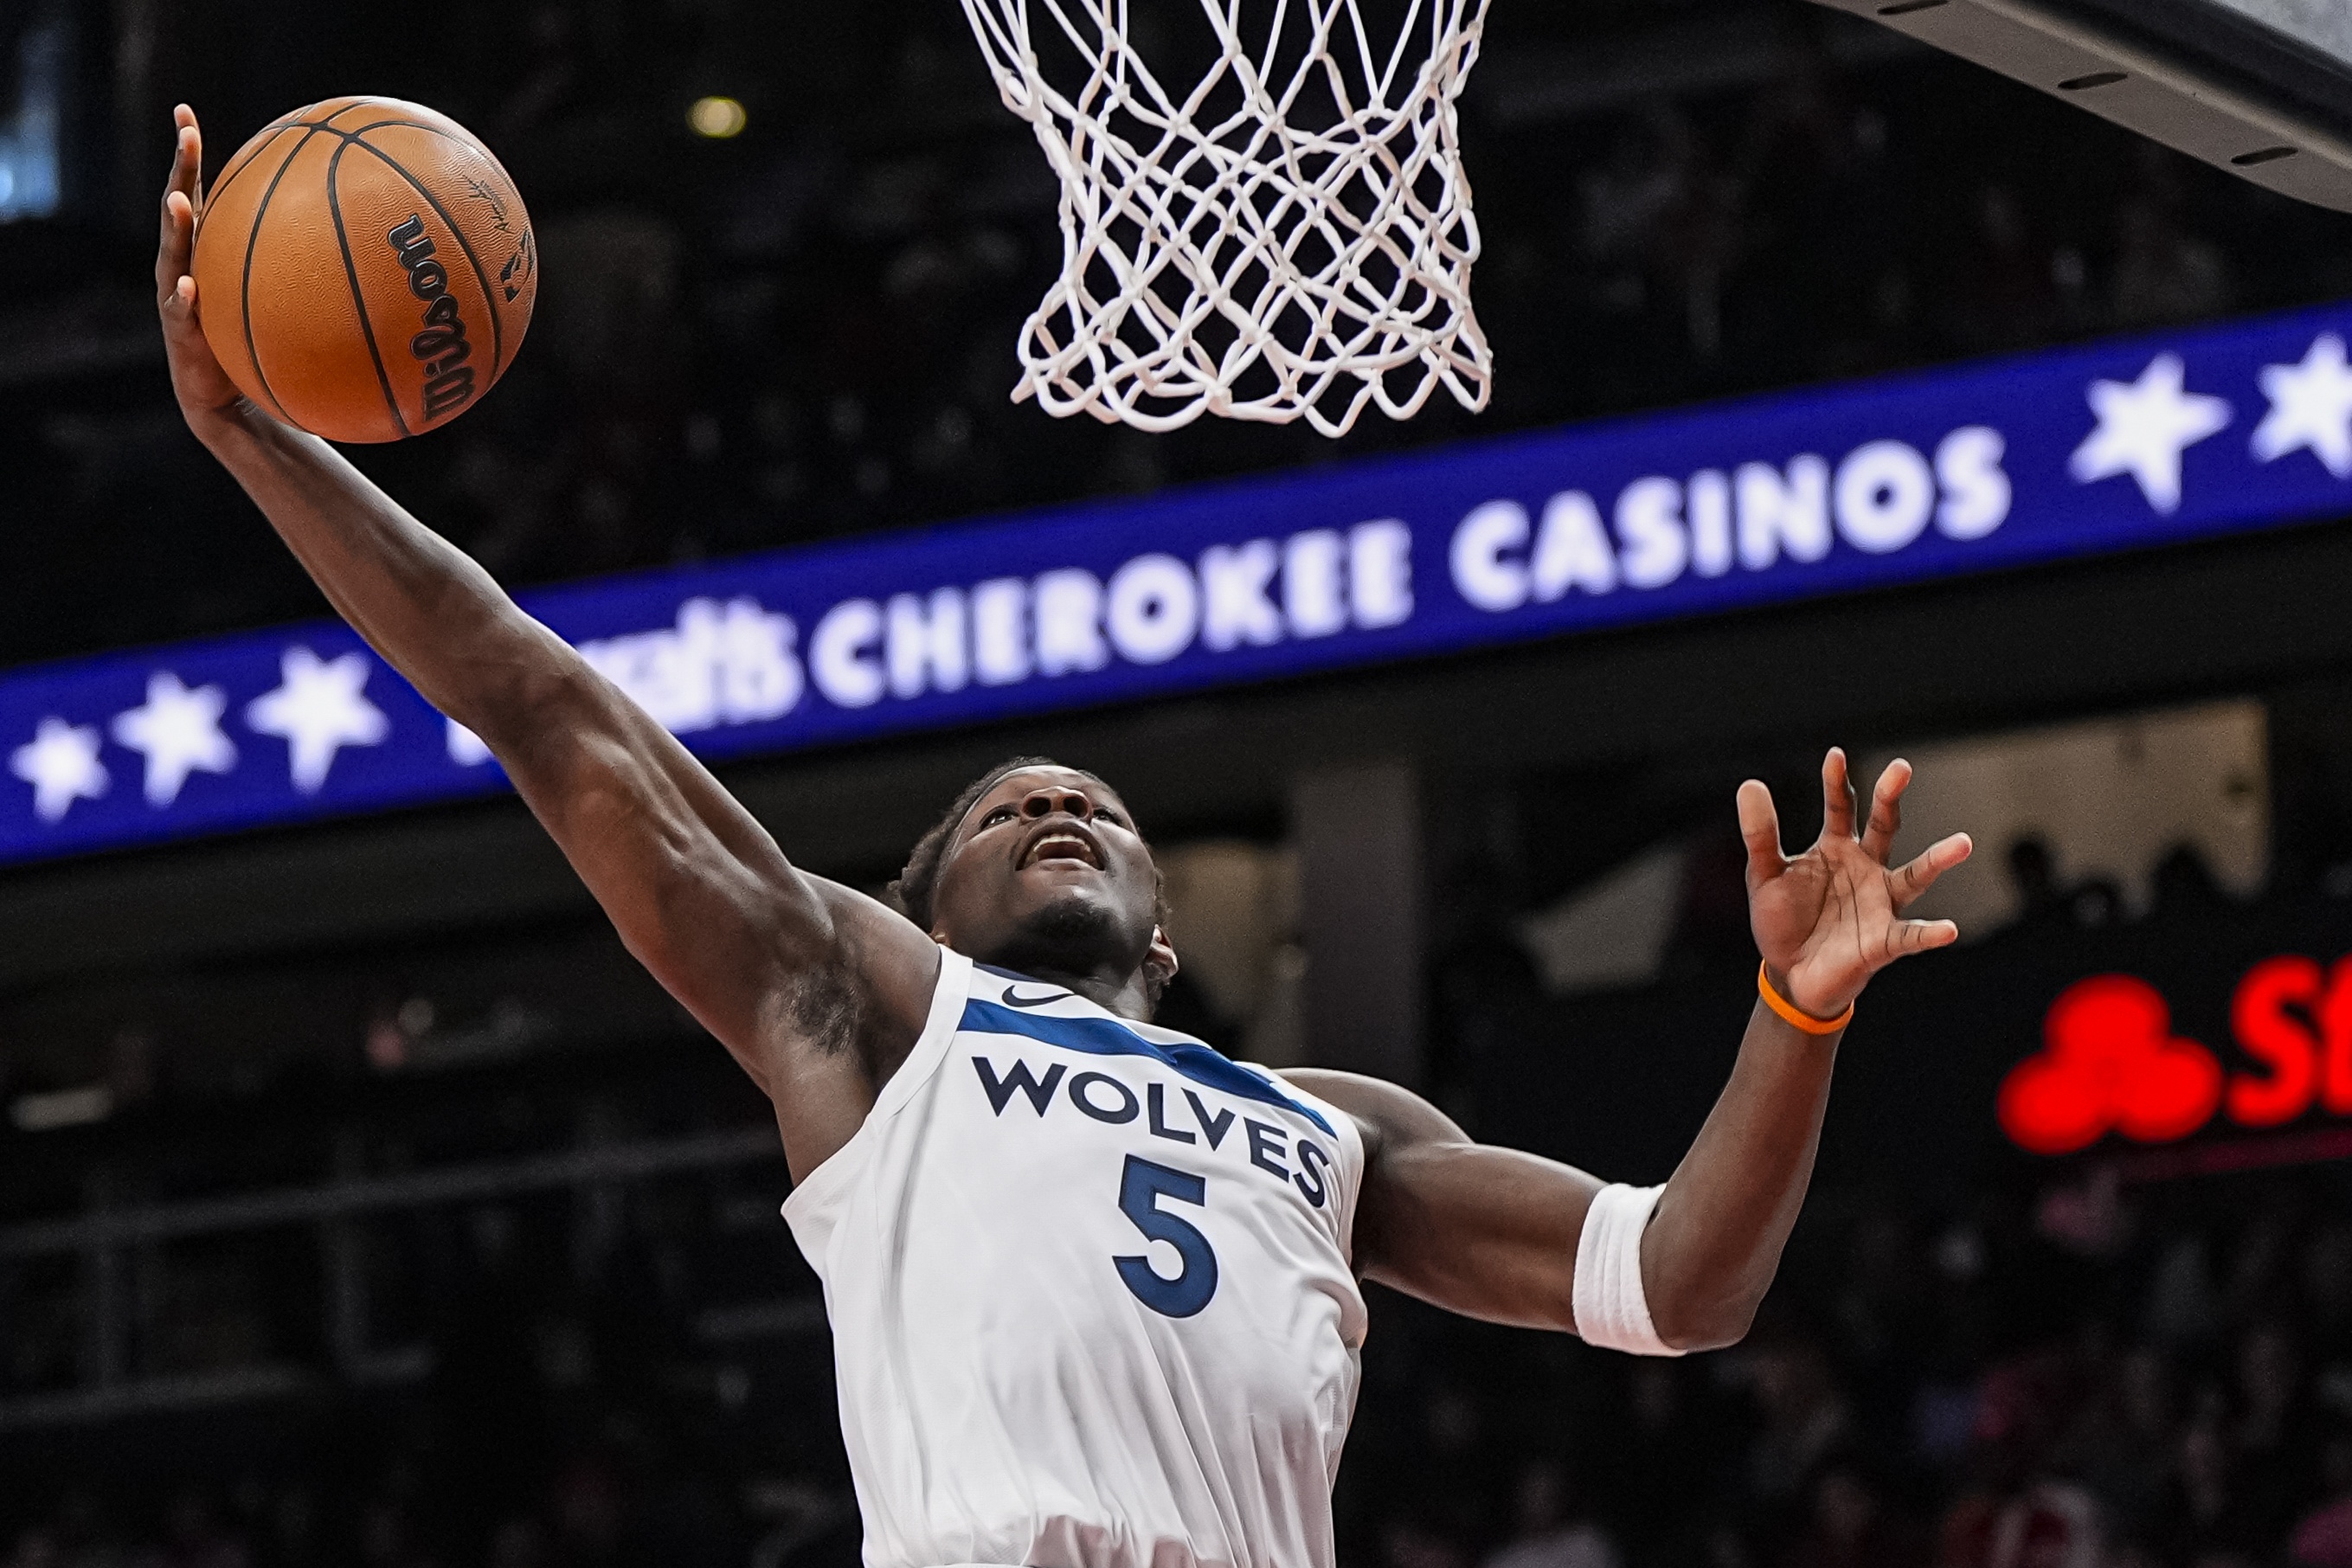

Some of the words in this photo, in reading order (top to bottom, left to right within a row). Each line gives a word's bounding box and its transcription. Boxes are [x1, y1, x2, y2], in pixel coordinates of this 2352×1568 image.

[388, 214, 476, 422] Wilson
[810, 517, 1414, 710] CHEROKEE
[1449, 424, 2013, 612] CASINOS
[971, 1055, 1331, 1210] WOLVES
[1111, 1153, 1219, 1319] 5
